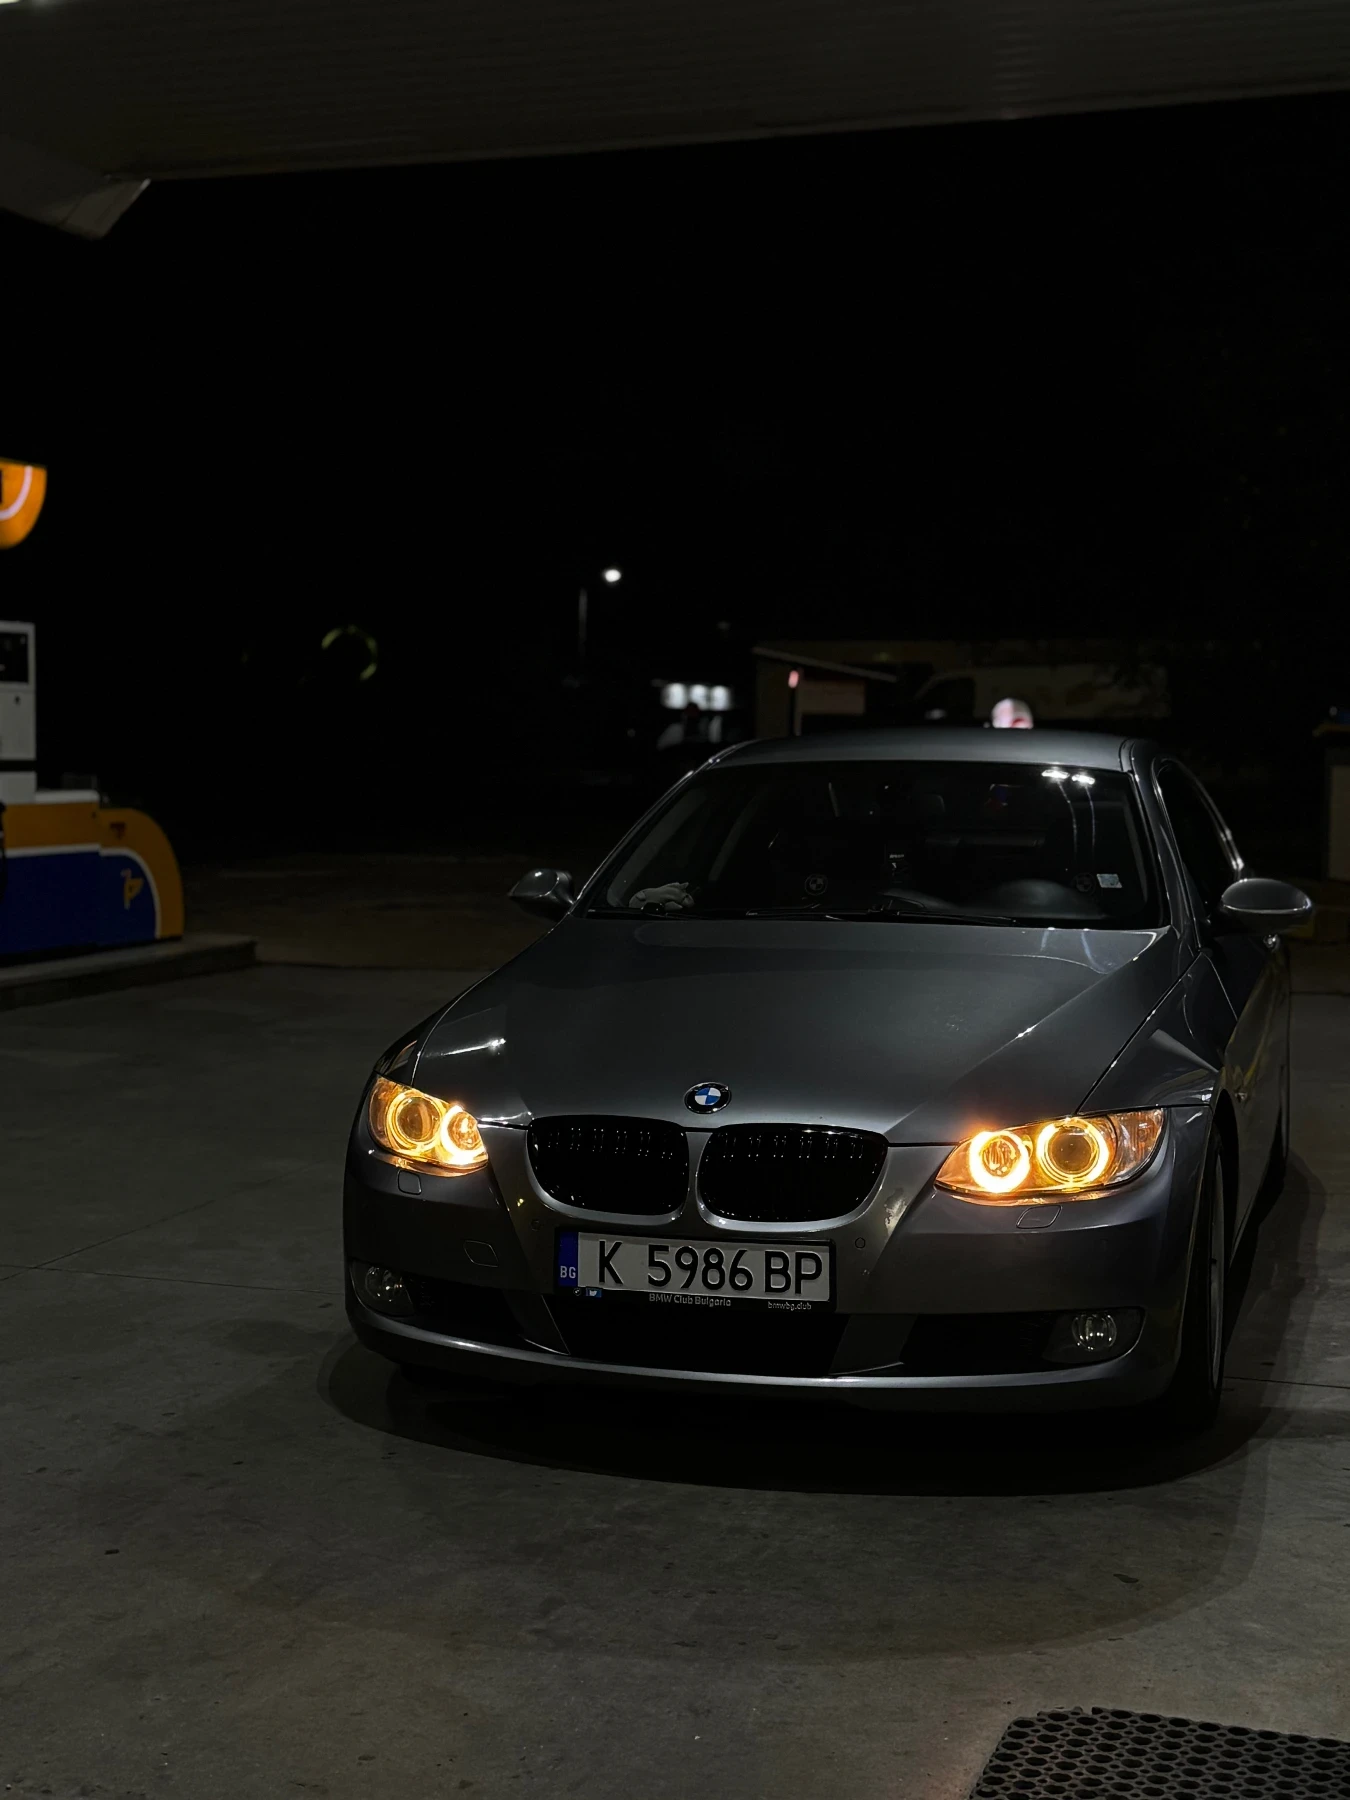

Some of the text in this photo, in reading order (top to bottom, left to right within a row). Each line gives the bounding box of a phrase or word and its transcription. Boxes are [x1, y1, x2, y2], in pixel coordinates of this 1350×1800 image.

[560, 1265, 577, 1279] BG
[599, 1240, 823, 1294] K 5986 BP
[649, 1293, 732, 1307] BMW Club Bulgaria
